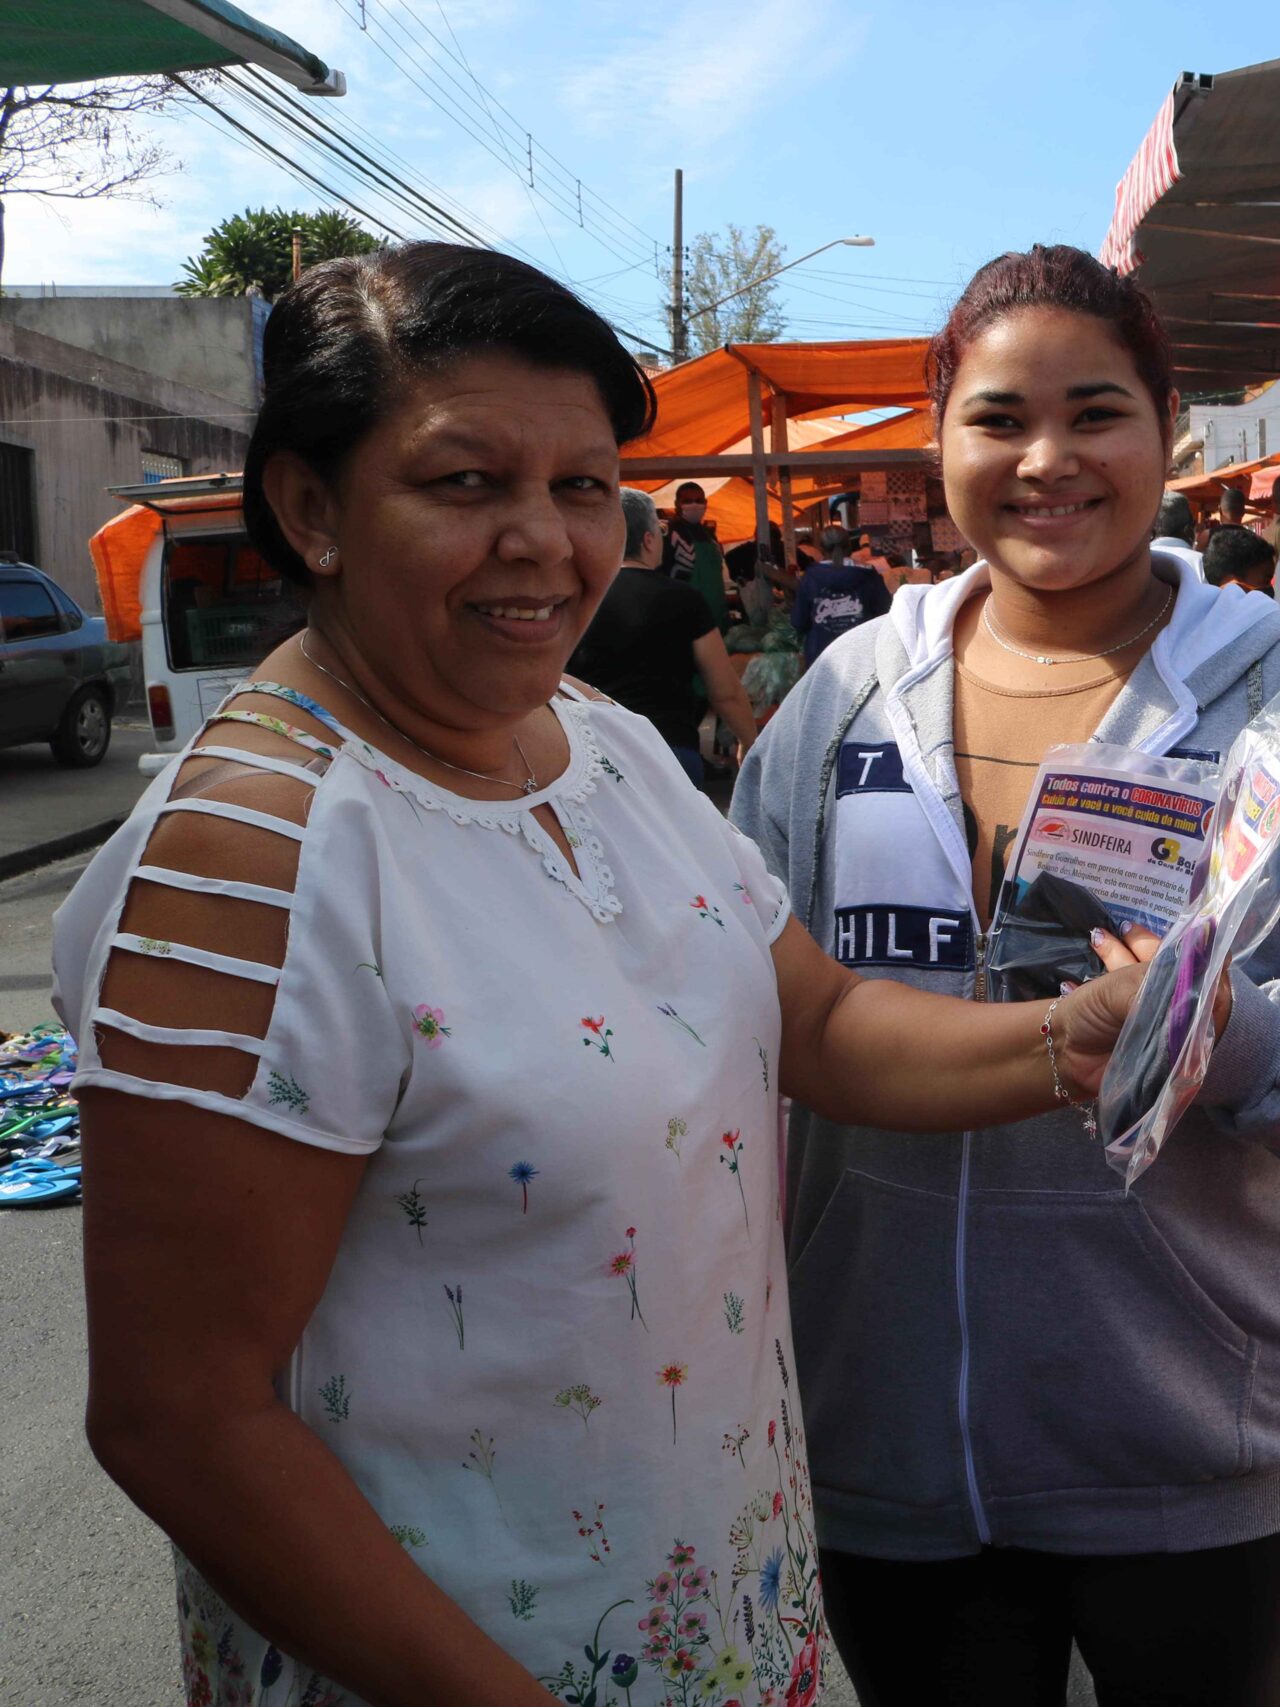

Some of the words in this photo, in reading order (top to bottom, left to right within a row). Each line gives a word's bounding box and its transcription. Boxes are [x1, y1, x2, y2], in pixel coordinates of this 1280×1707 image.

[1047, 777, 1079, 791] Todos
[1080, 782, 1120, 797] contra
[1121, 788, 1129, 799] o
[1131, 787, 1203, 816] CORONAVÍRUS
[1071, 829, 1131, 855] SINDFEIRA
[1177, 856, 1197, 870] Bai
[1098, 864, 1123, 877] parceria
[1124, 870, 1138, 879] com
[1104, 877, 1117, 886] está
